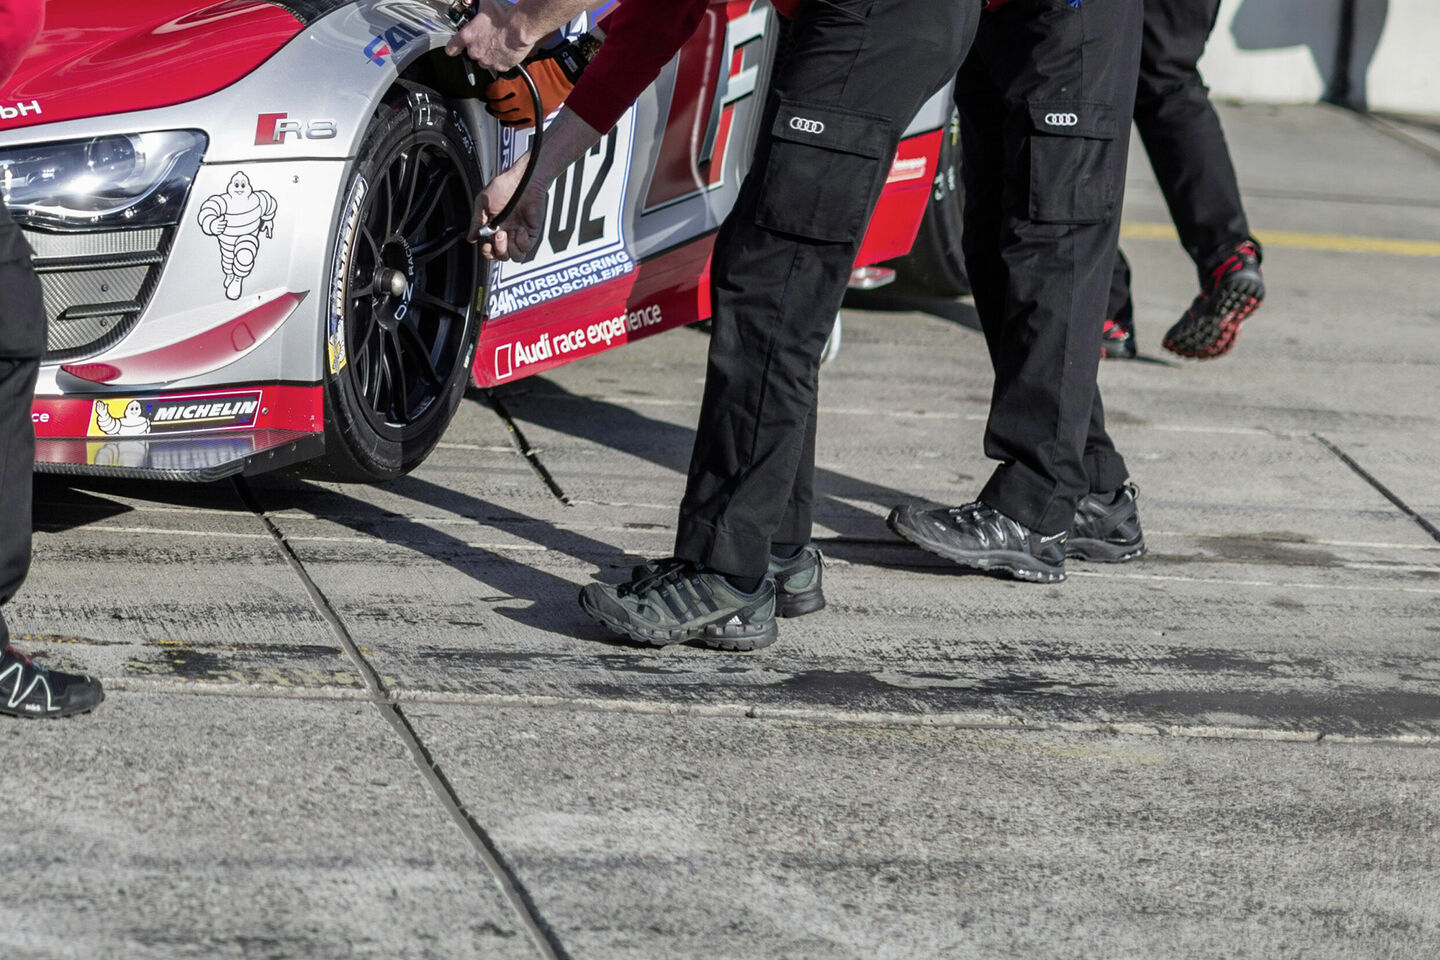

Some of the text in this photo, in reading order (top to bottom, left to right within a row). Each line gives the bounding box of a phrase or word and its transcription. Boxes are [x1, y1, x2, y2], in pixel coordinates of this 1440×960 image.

[271, 117, 338, 141] R8
[489, 292, 517, 320] 24h
[515, 261, 634, 309] NORDSCHLEIFE
[512, 250, 630, 298] NÜRBURGRING
[514, 332, 554, 368] Audi
[553, 328, 586, 356] race
[586, 303, 662, 346] experience
[154, 401, 258, 421] MICHELIN
